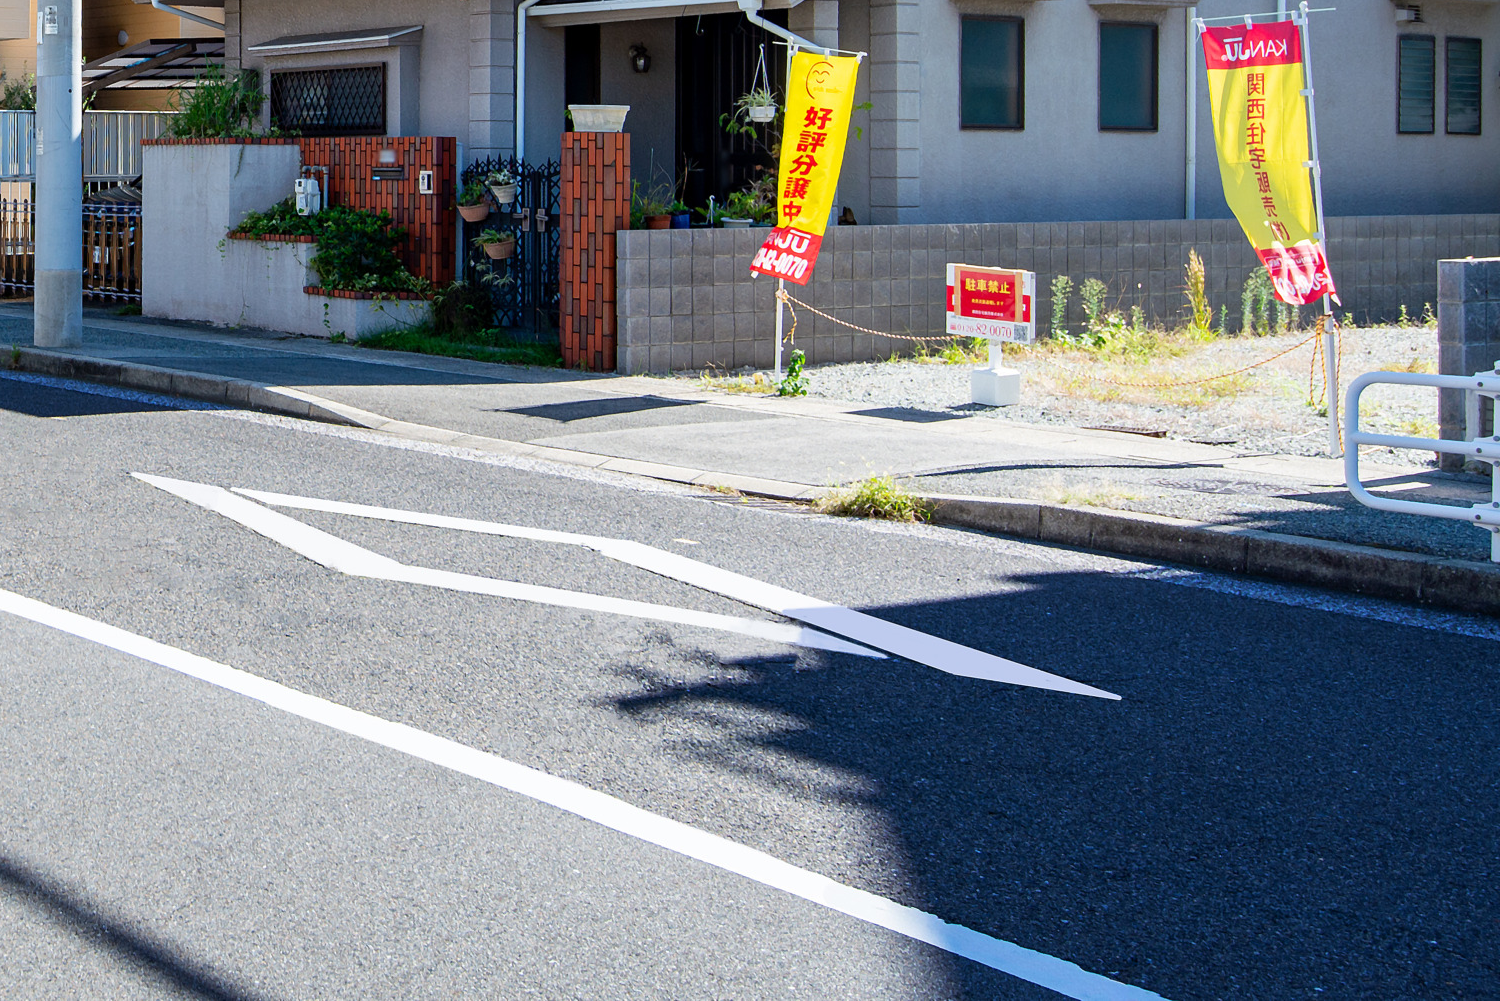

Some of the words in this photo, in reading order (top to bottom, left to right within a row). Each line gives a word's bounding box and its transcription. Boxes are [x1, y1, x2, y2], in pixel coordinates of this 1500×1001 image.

[783, 105, 833, 222] 好評分譲中
[965, 278, 1011, 294] 駐車禁止
